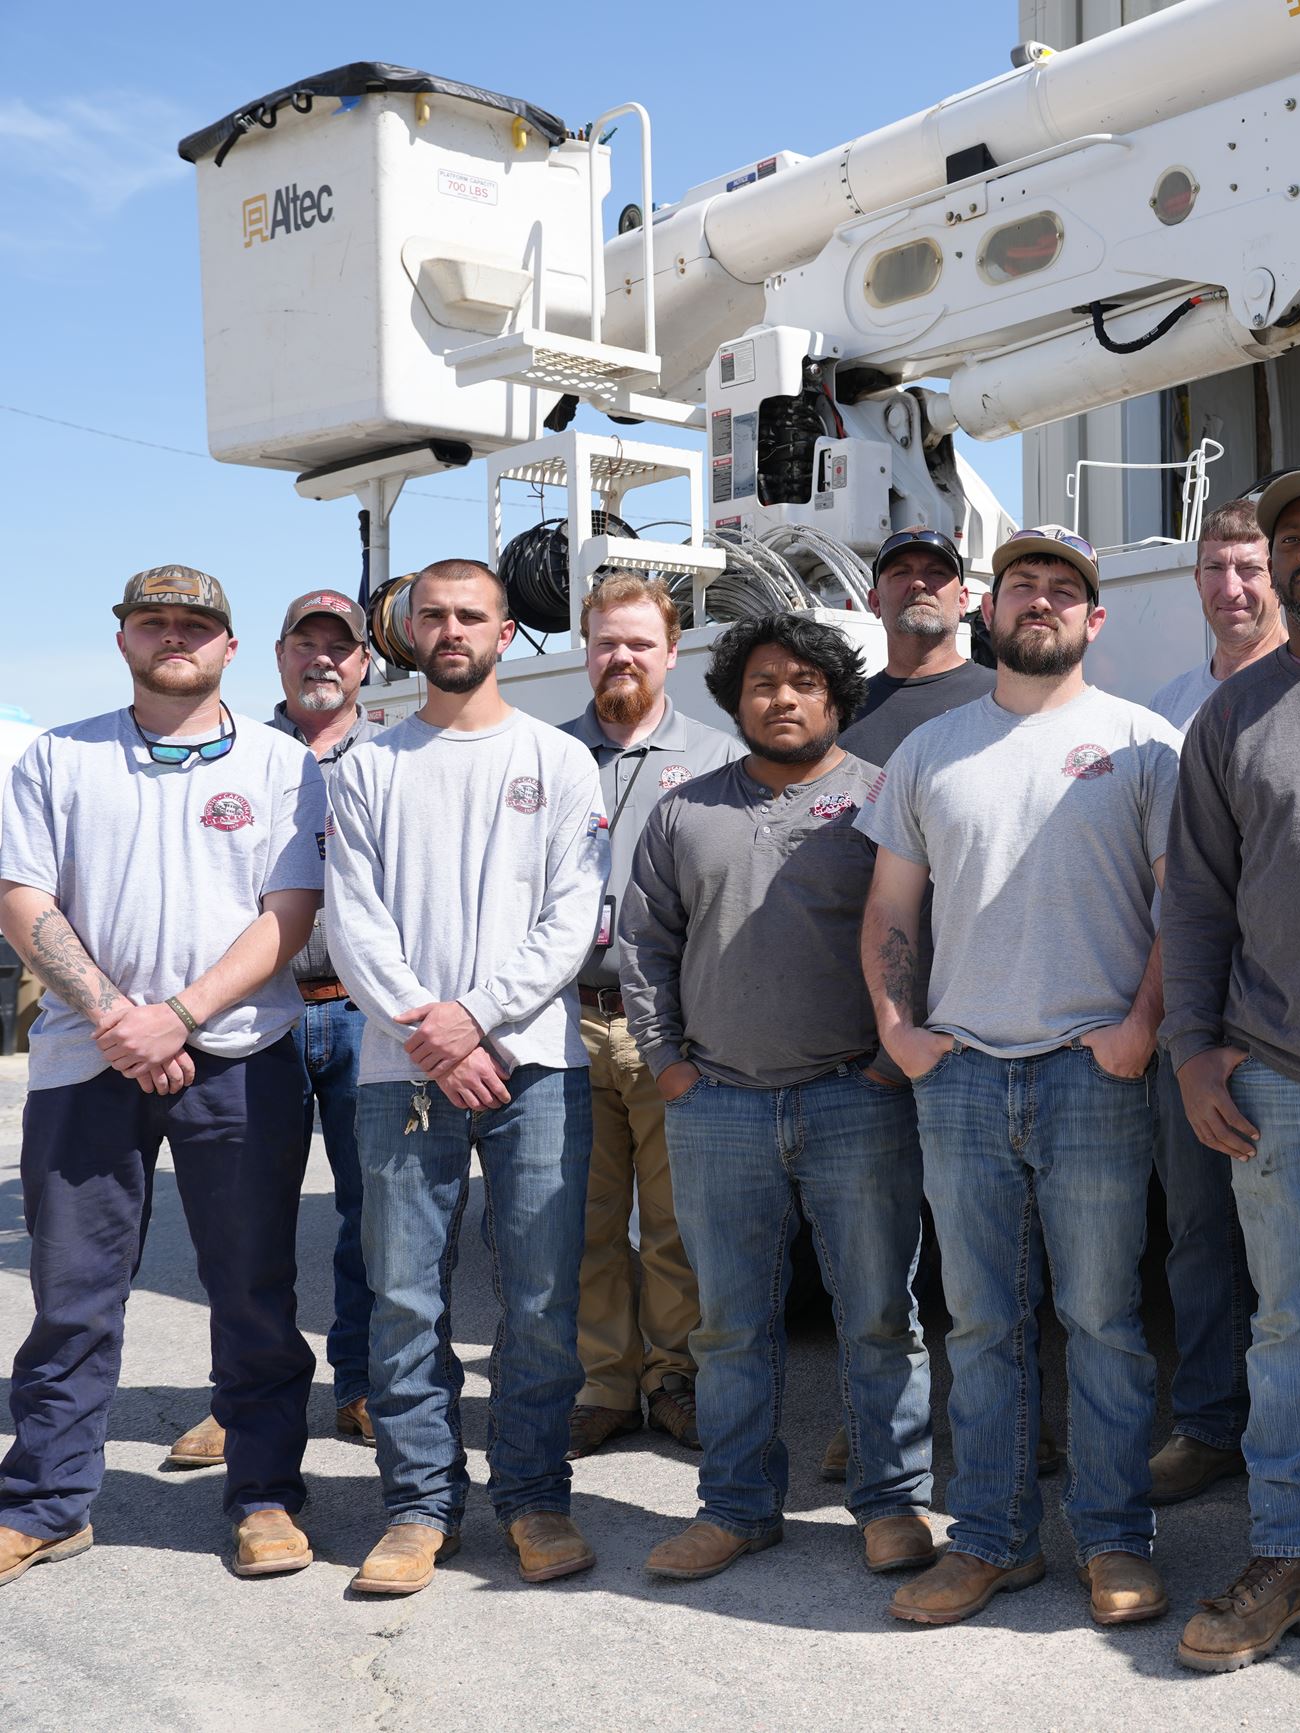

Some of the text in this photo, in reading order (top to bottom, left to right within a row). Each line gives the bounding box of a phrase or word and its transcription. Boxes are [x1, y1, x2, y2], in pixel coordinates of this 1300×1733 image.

[448, 180, 466, 193] 700
[469, 184, 489, 199] LBS
[270, 183, 333, 240] Altec
[223, 793, 250, 816] CAROLINA
[814, 796, 852, 816] CLAYTON
[205, 815, 251, 825] CLAYTON
